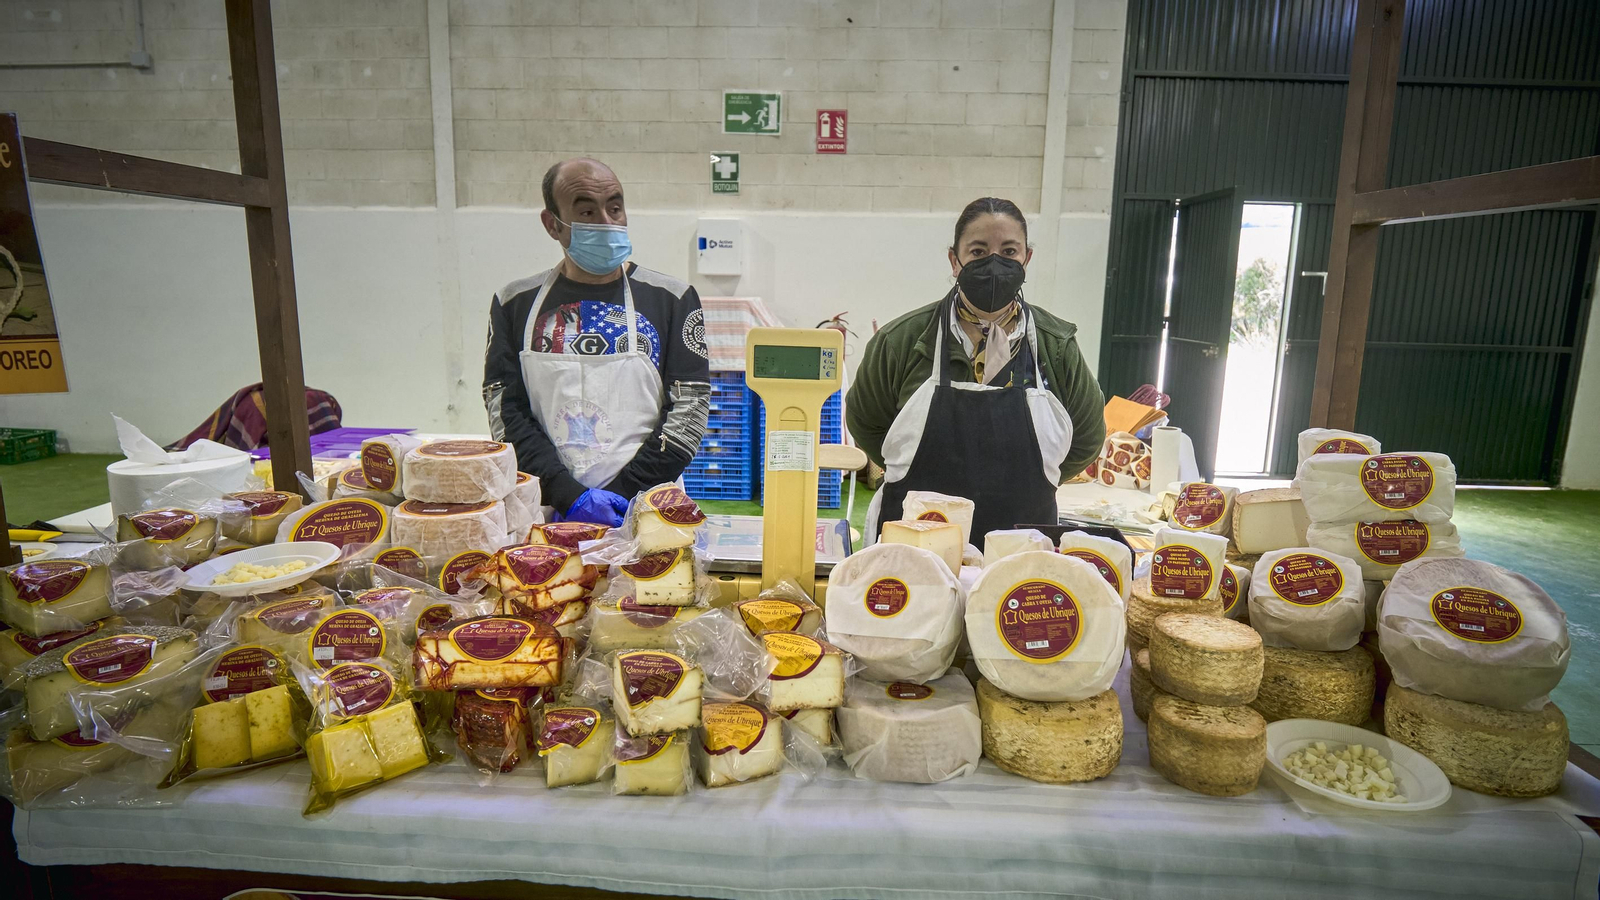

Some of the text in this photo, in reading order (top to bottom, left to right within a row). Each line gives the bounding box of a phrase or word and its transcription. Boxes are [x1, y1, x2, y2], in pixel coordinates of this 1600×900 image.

[580, 338, 598, 354] G
[1379, 468, 1429, 481] Quesos de Ubrique
[1185, 498, 1200, 507] Quesos
[1206, 497, 1222, 506] Ubrique
[318, 520, 378, 535] Quesos de Ubrique
[1375, 526, 1425, 538] Quesos de Ubrique
[1163, 565, 1209, 578] Quesos de Ubrique
[1287, 572, 1307, 581] Quesos
[1315, 568, 1336, 577] Ubrique
[1019, 606, 1075, 624] Quesos de Ubrique
[1454, 602, 1516, 619] Quesos de Ubrique
[332, 634, 380, 646] Quesos de Ubrique
[766, 641, 786, 649] Quesos
[226, 670, 248, 681] Quesos
[249, 668, 256, 677] de
[626, 666, 646, 674] Quesos
[655, 668, 677, 682] Ubrique
[336, 684, 357, 694] Quesos
[363, 675, 386, 685] Ubrique
[705, 714, 726, 724] Quesos
[737, 716, 761, 730] Ubrique
